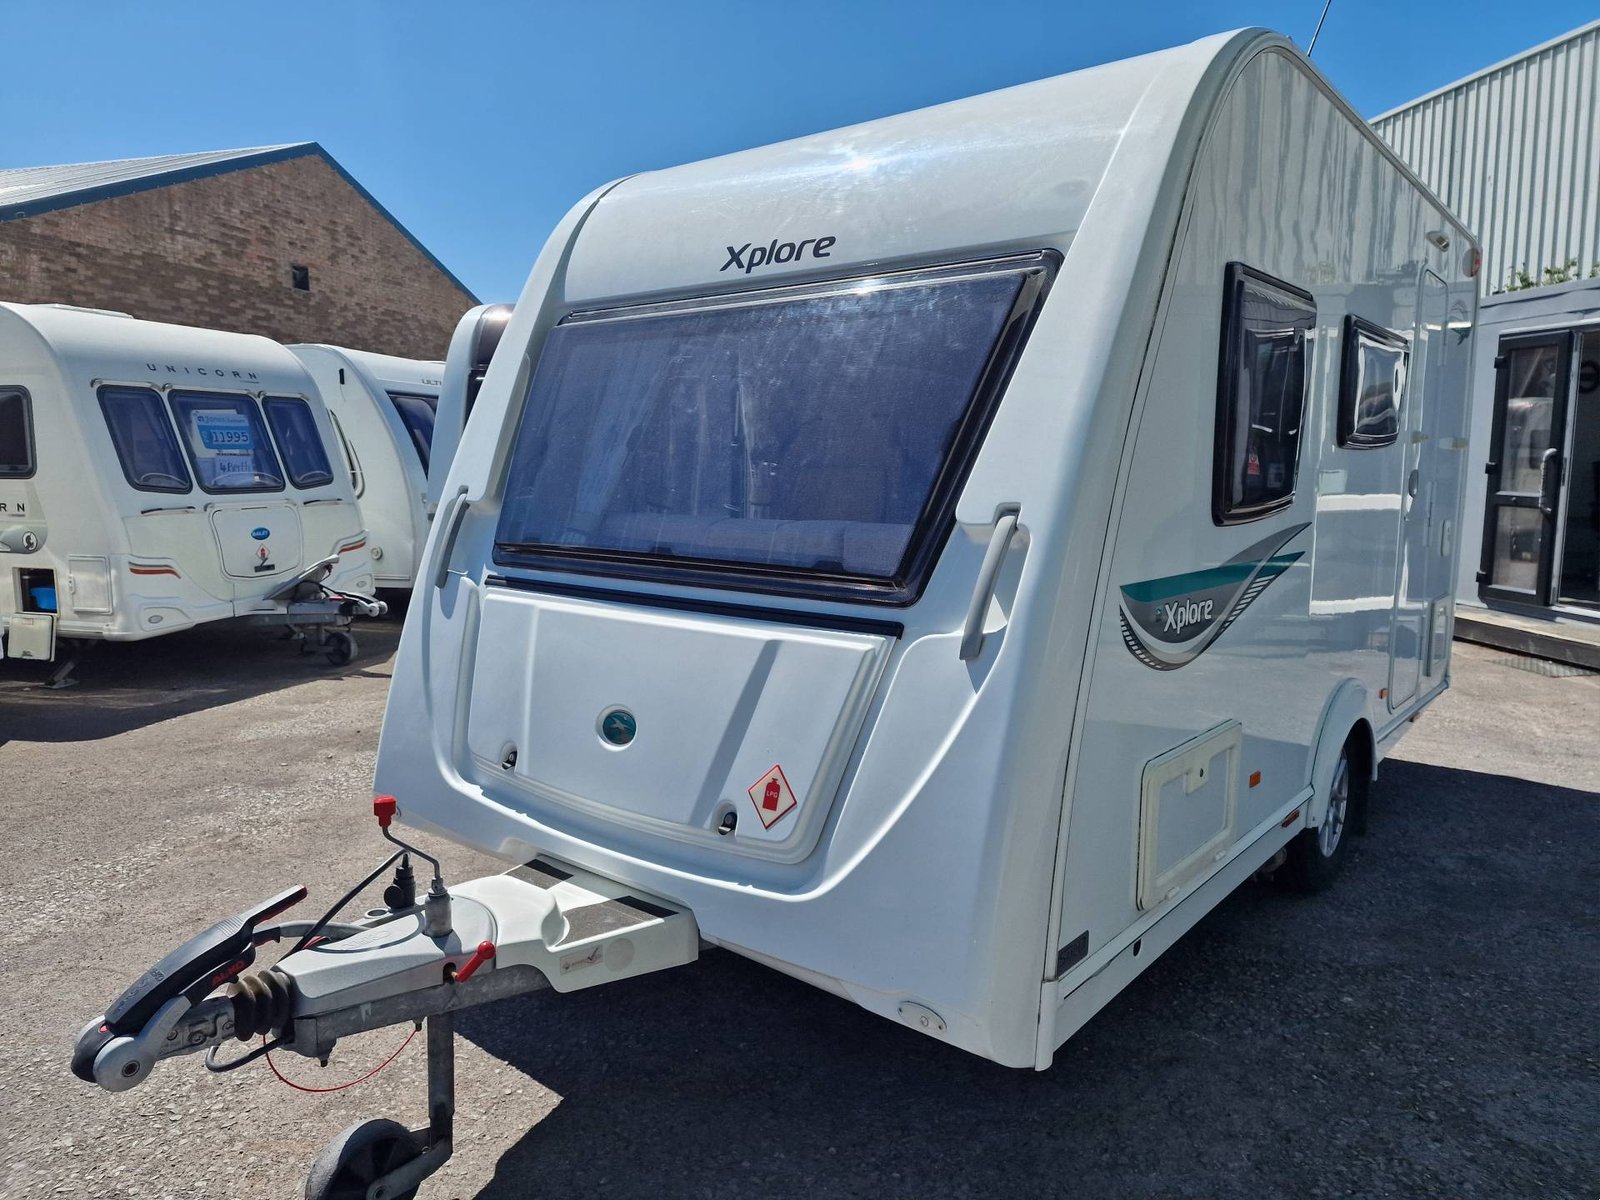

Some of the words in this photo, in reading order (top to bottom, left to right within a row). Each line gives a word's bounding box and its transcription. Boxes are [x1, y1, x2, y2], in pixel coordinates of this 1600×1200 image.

[719, 236, 837, 274] Xplore
[146, 363, 257, 380] UNICORN
[1163, 599, 1213, 634] Xplore
